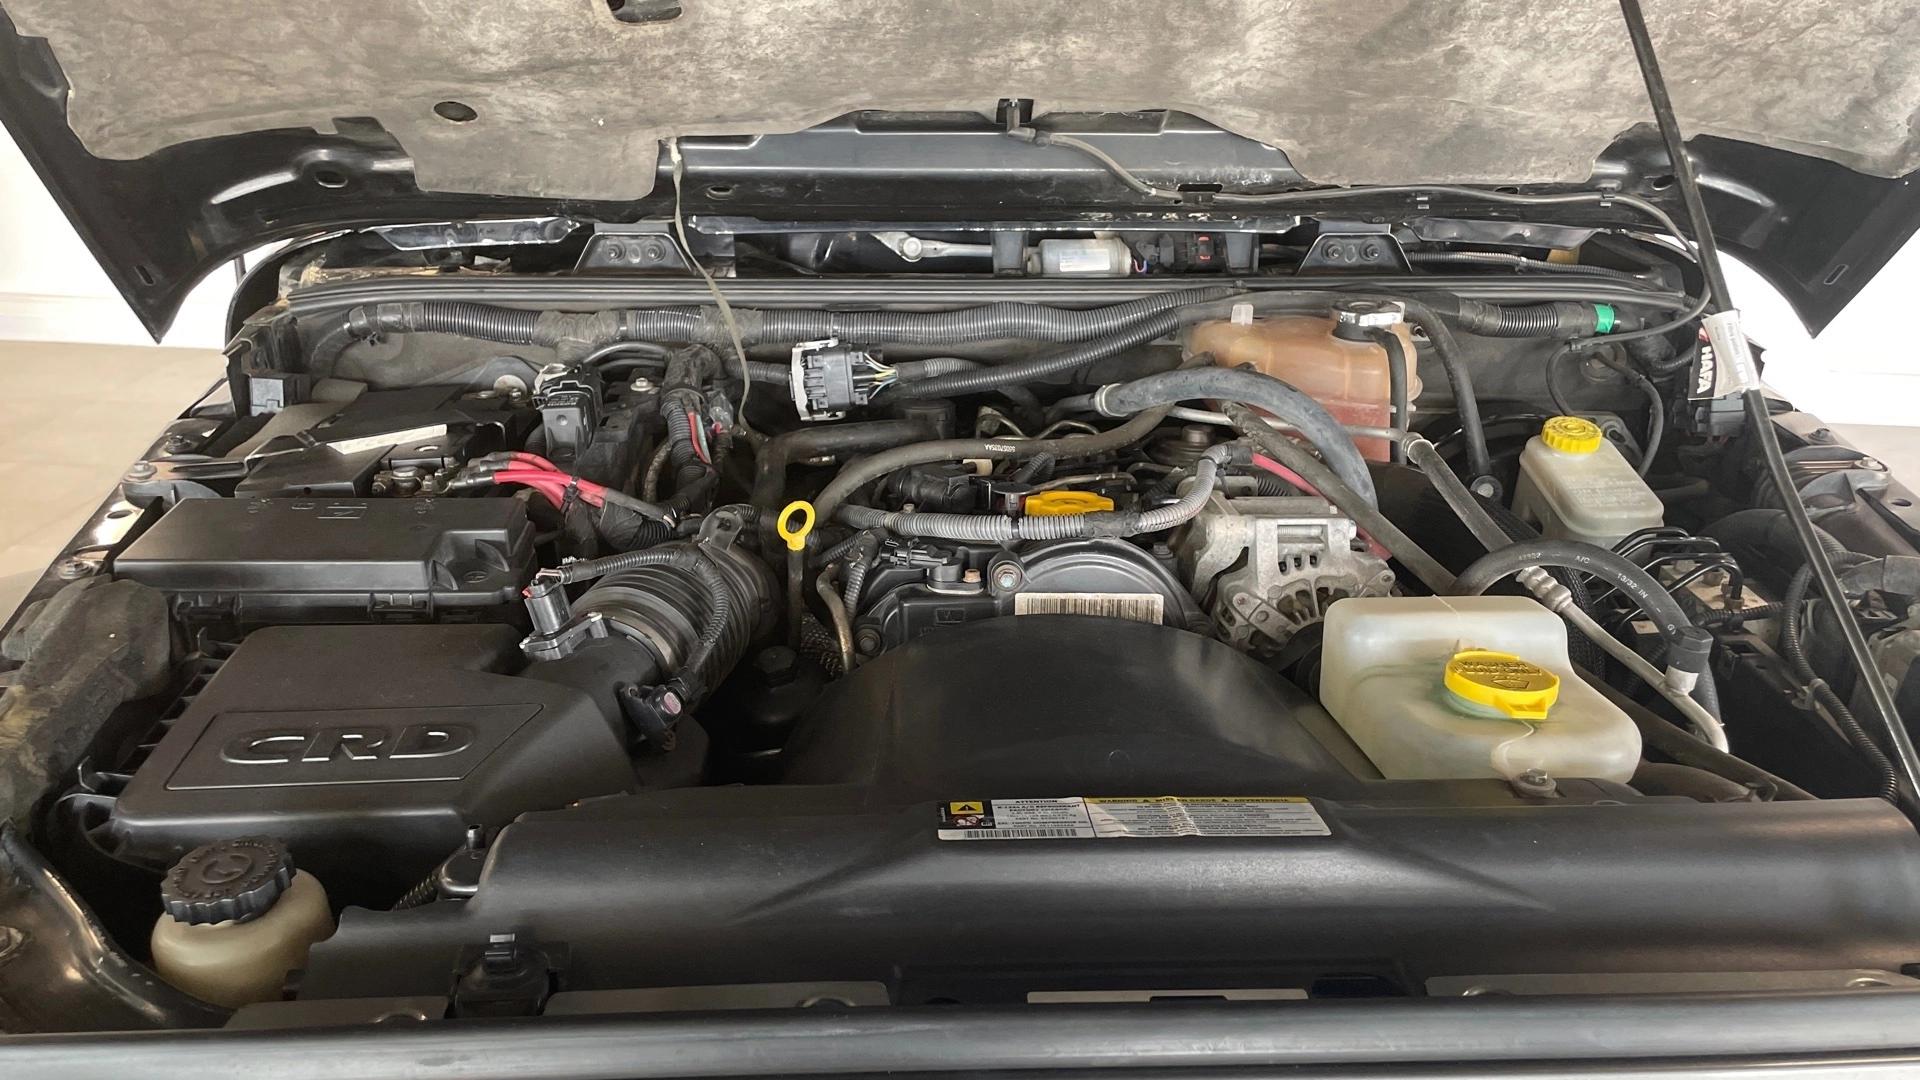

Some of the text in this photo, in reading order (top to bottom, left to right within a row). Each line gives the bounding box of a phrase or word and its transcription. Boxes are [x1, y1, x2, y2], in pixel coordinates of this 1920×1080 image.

[1697, 345, 1713, 394] HAFA
[1574, 554, 1591, 565] A/C
[220, 723, 474, 764] CRD
